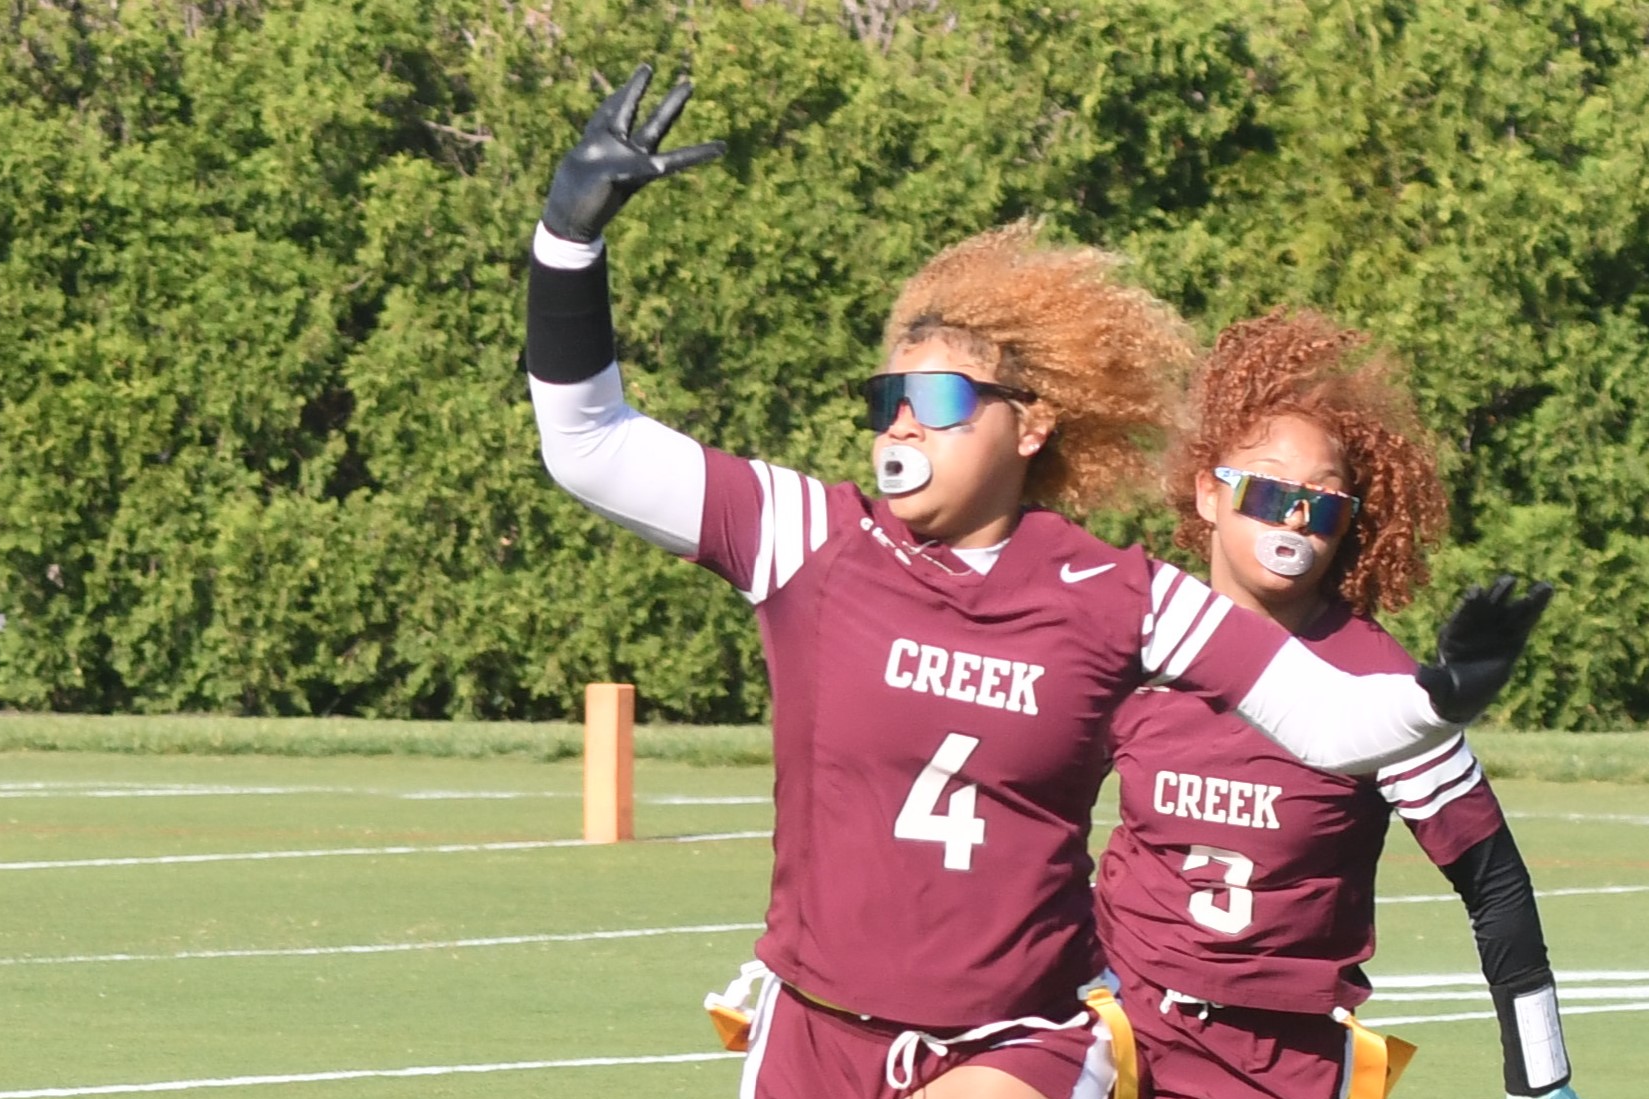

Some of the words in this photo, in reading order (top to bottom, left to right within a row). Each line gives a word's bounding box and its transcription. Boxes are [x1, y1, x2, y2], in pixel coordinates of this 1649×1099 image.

[884, 638, 1045, 716] CREEK
[894, 732, 986, 871] 4
[1153, 770, 1283, 829] CREEK
[1182, 844, 1254, 935] 3
